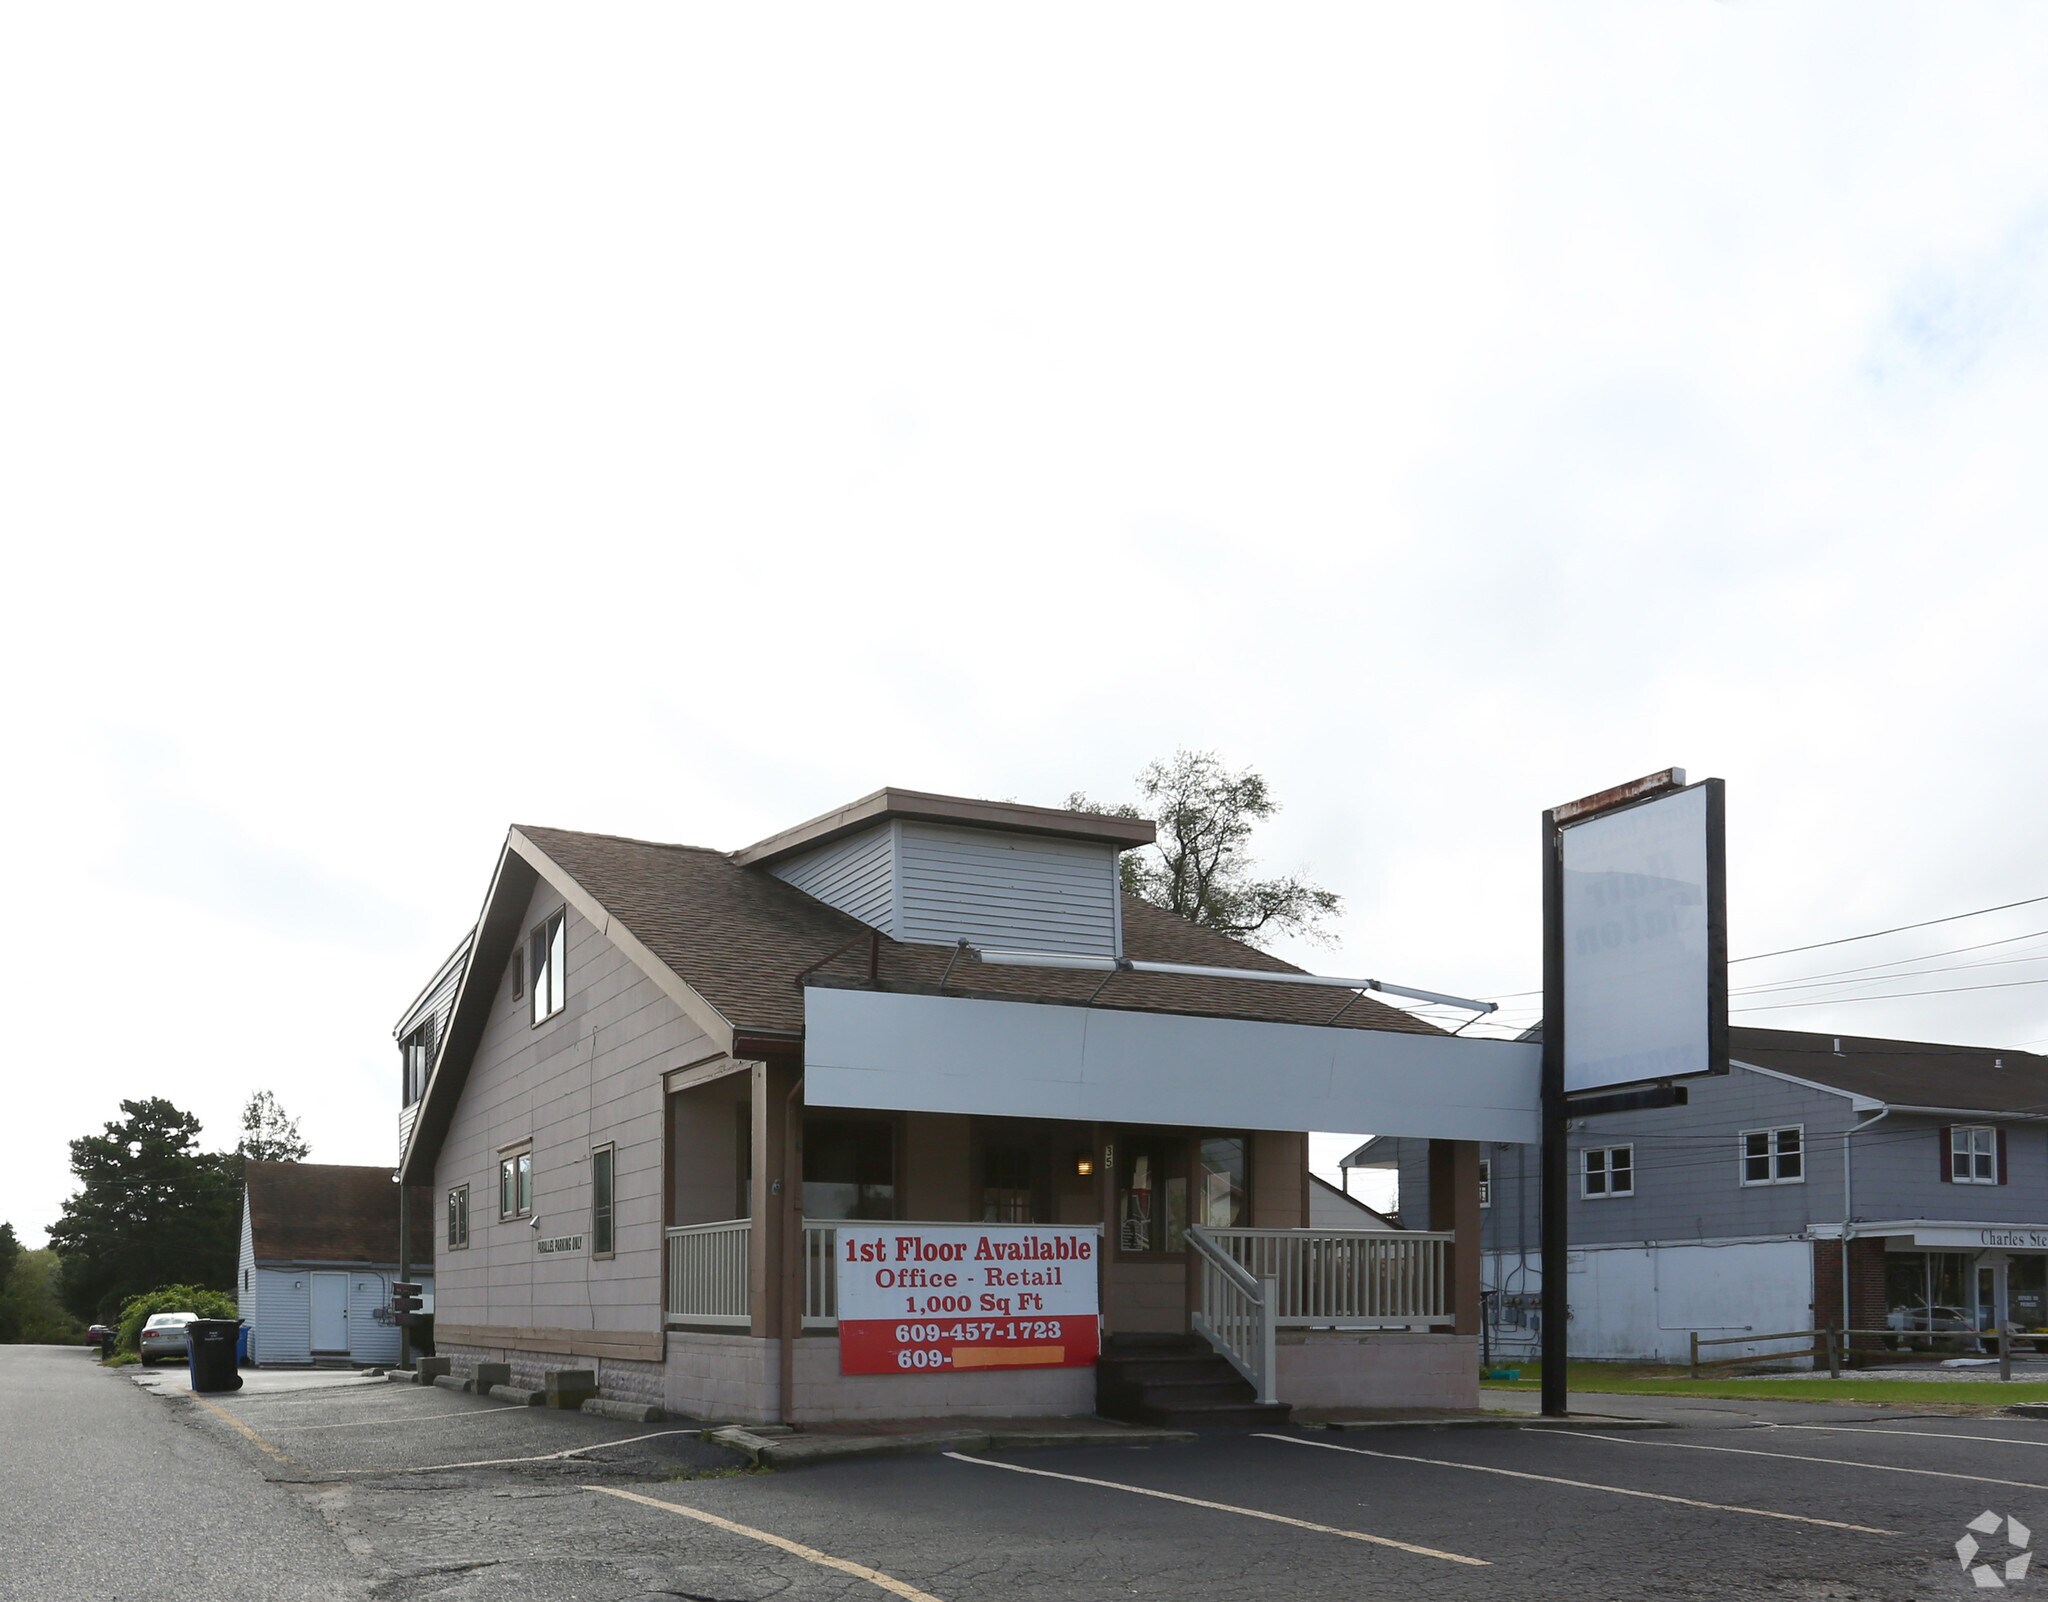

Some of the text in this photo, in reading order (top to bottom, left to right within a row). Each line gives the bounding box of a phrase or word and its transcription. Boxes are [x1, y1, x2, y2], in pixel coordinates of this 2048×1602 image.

[1106, 1146, 1112, 1167] 35
[555, 1237, 571, 1252] PARKING
[572, 1235, 582, 1250] ONLY
[1981, 1230, 2024, 1246] Charles
[846, 1236, 1092, 1263] 1st Floor Available
[875, 1268, 957, 1289] Office
[984, 1267, 1062, 1287] Retail
[906, 1292, 1043, 1316] 1,000 Sq Ft
[895, 1320, 1062, 1343] 609-457-1723
